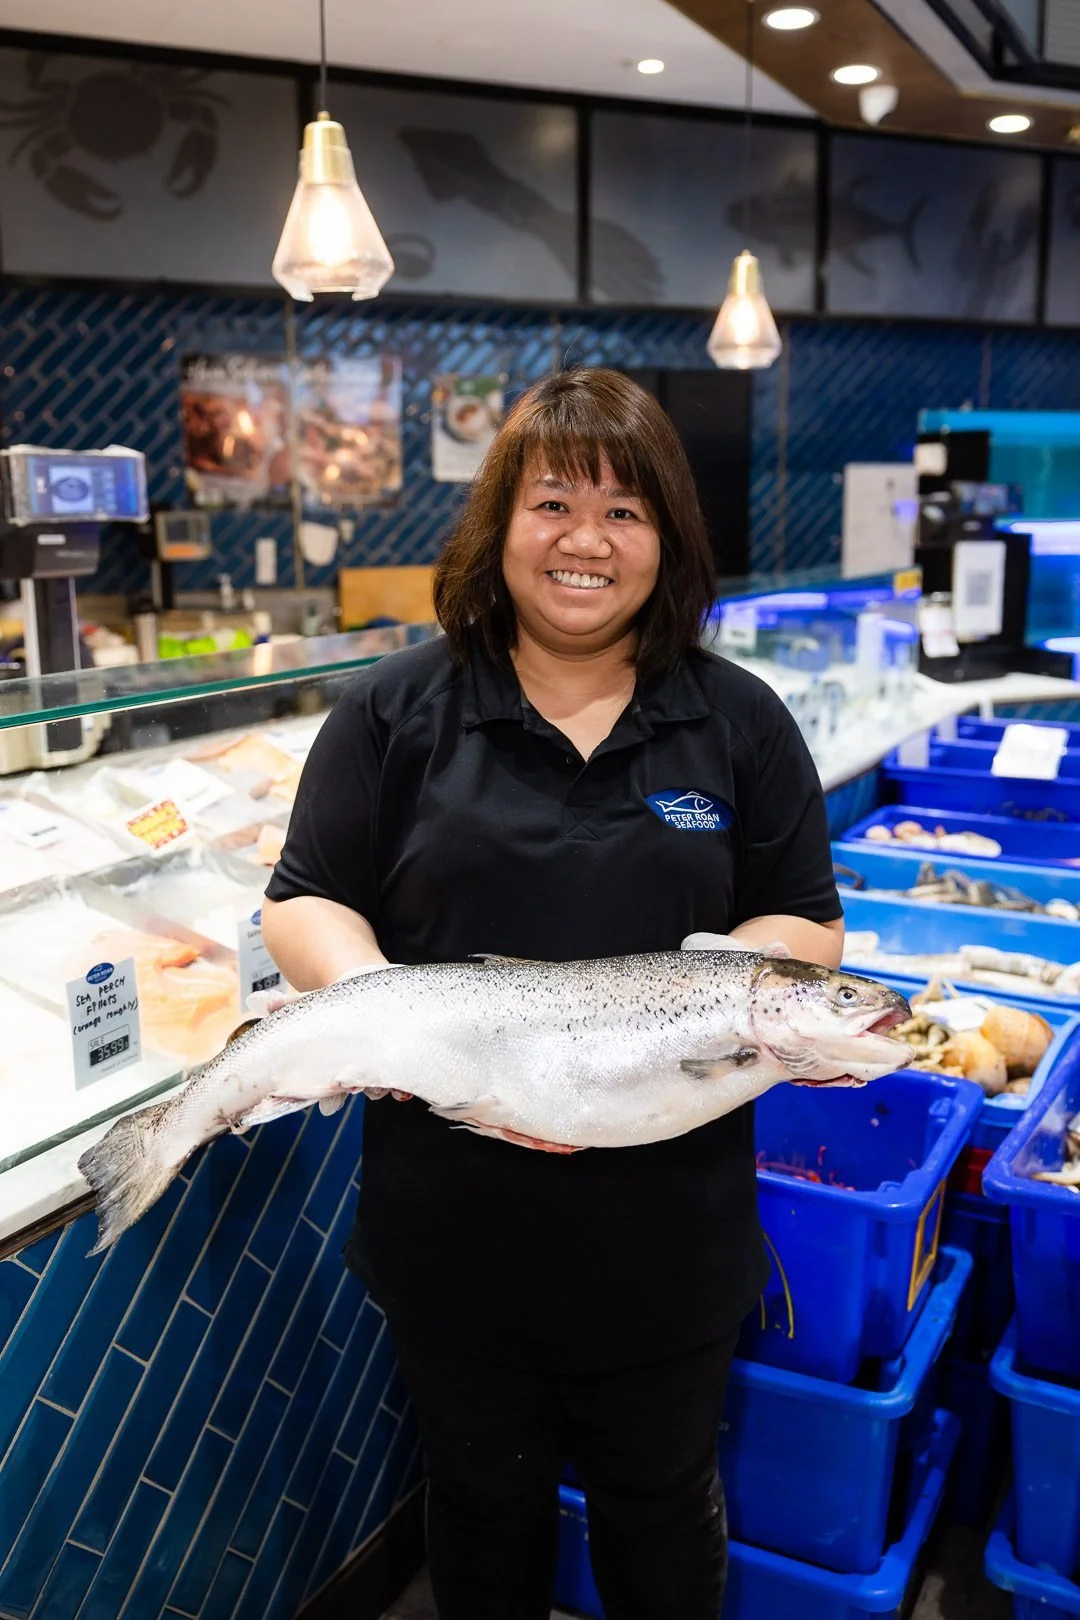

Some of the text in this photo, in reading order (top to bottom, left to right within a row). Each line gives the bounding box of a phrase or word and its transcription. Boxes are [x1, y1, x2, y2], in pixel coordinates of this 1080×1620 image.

[664, 813, 720, 823] PETER ROAN
[675, 821, 716, 829] SEAFOOD
[76, 993, 92, 1007] SEA
[98, 975, 126, 998] PERCH
